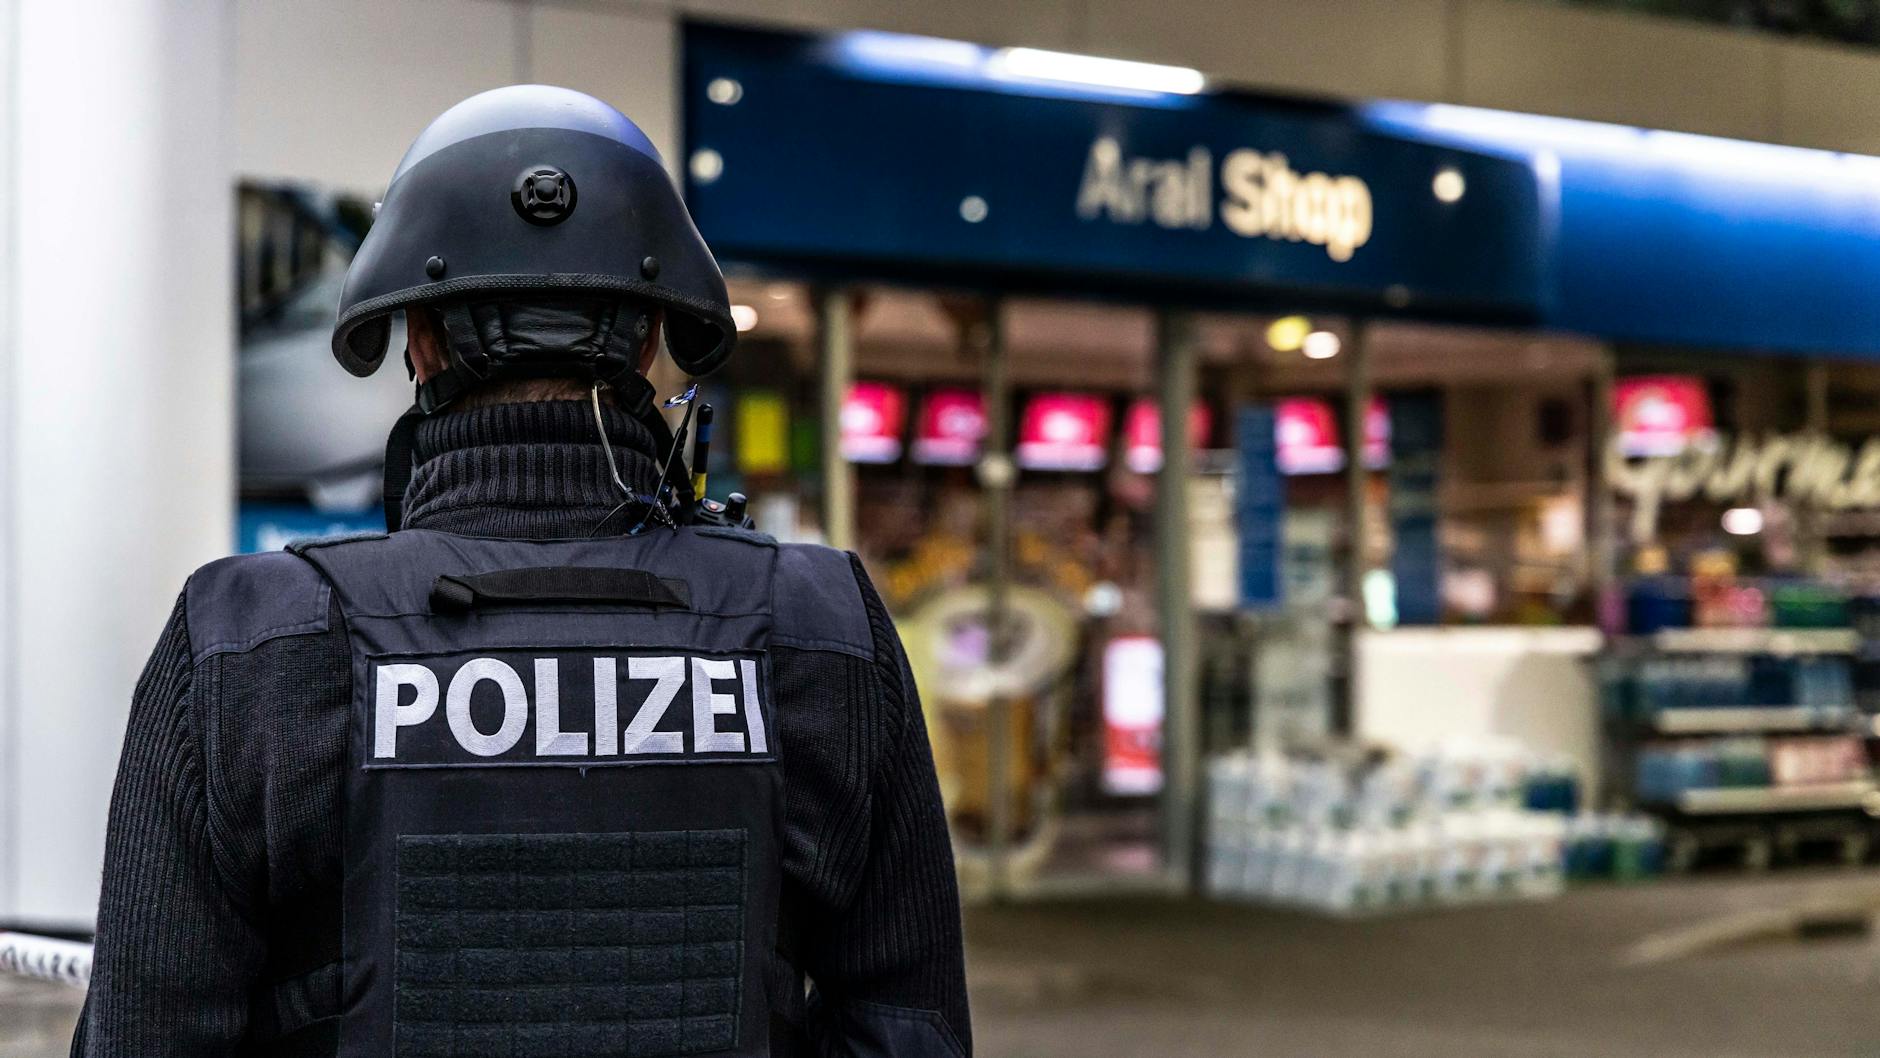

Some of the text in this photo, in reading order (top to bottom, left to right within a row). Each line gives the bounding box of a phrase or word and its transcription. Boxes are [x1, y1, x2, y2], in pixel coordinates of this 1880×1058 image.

[1076, 136, 1373, 263] Aral Shop
[373, 656, 769, 759] POLIZEI
